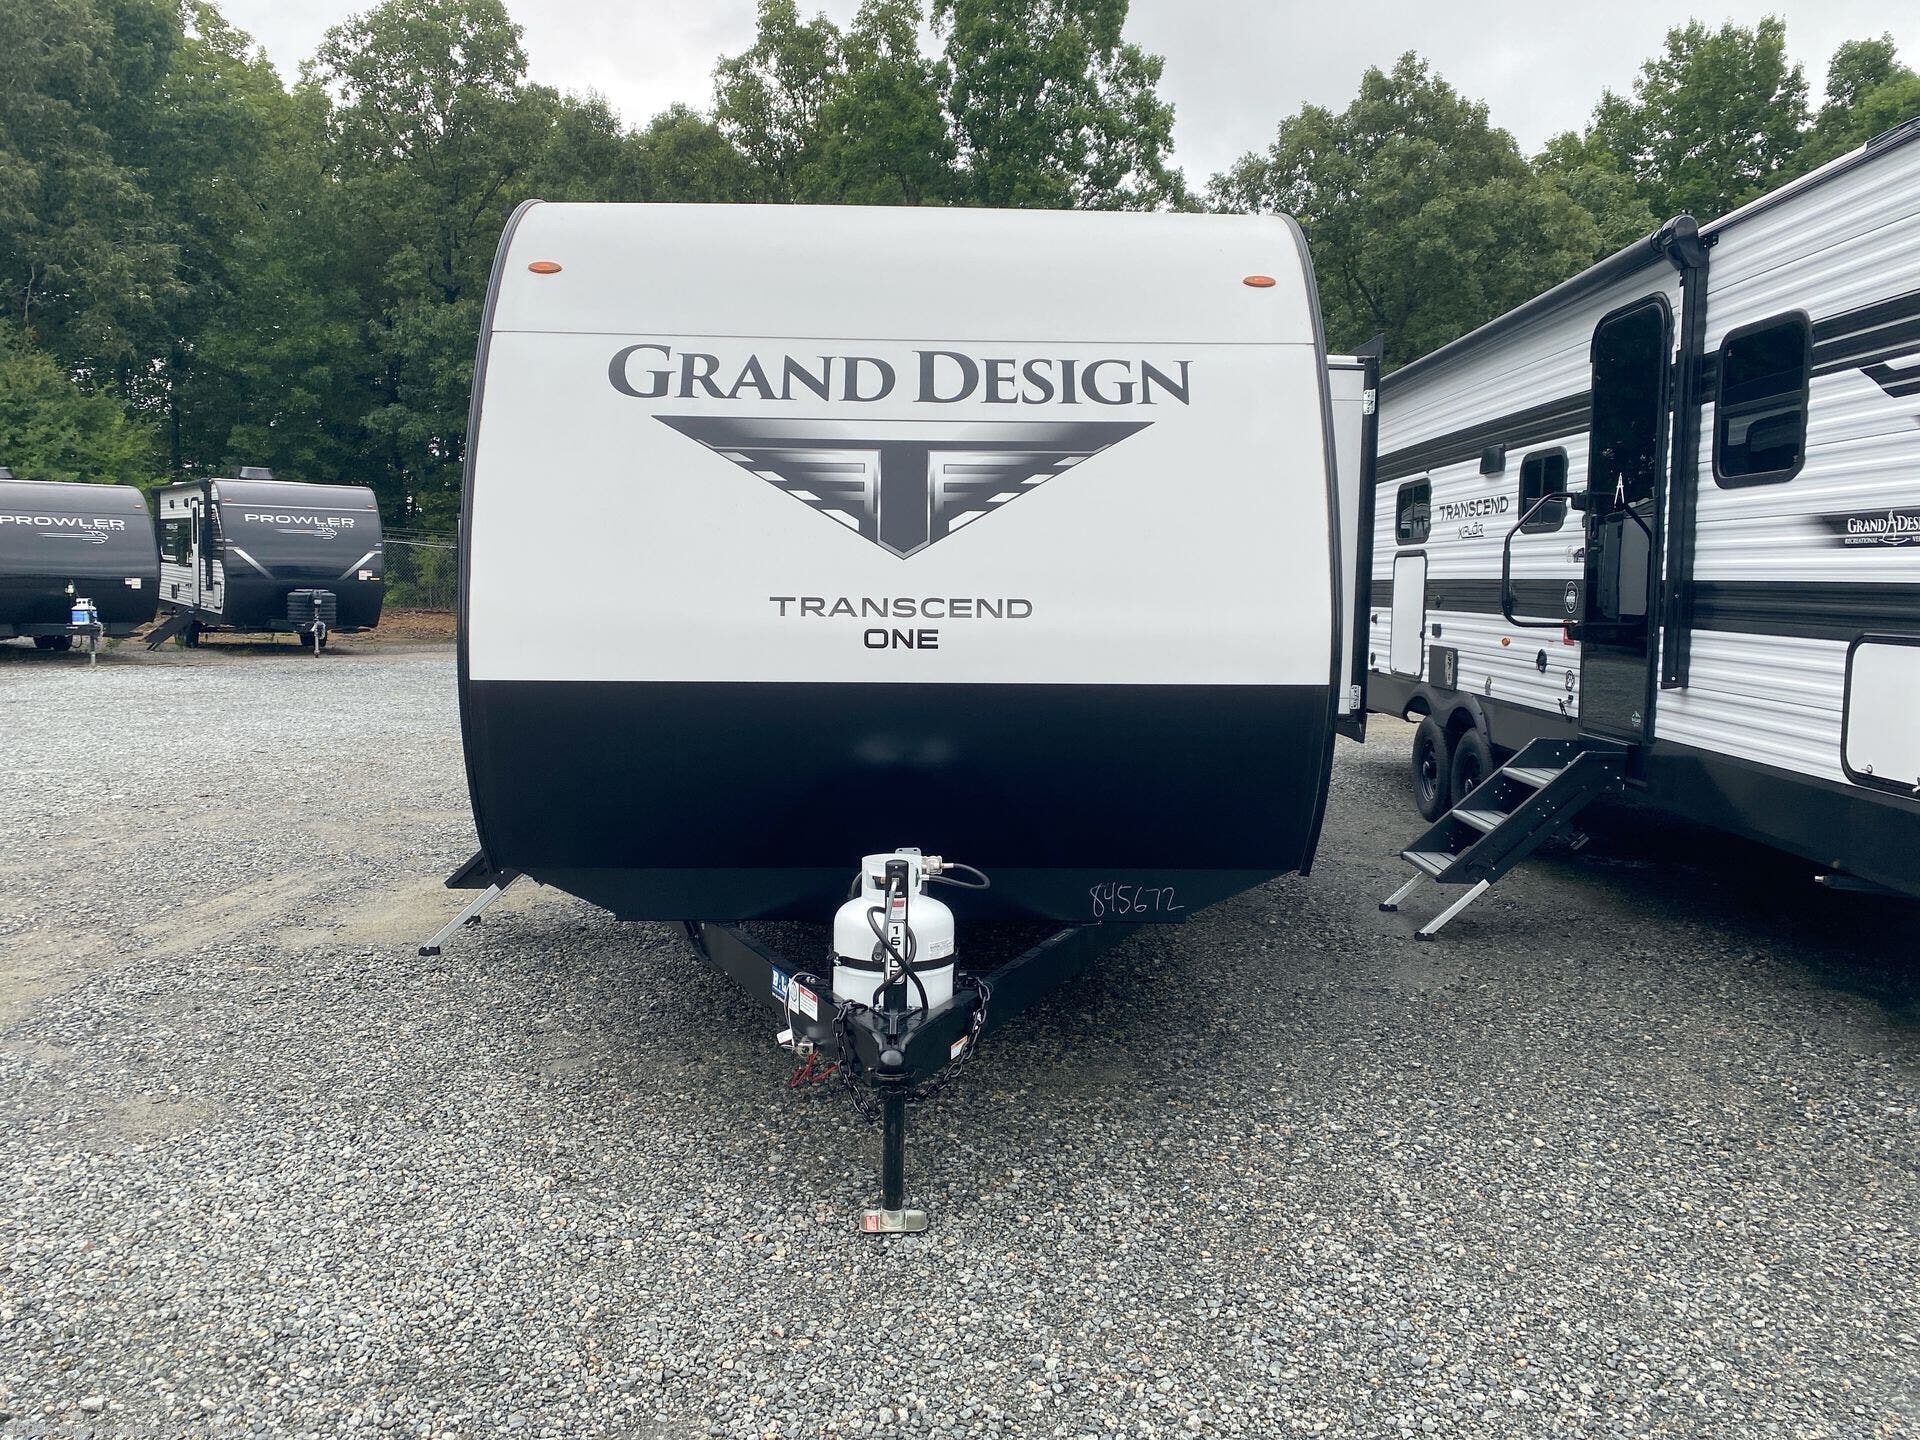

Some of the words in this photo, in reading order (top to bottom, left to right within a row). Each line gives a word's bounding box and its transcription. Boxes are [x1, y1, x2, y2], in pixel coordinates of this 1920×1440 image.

[608, 343, 896, 402] GRAND
[912, 350, 1194, 406] DESIGN
[244, 513, 355, 526] PROWLER
[1439, 496, 1509, 521] TRANSCEND
[1847, 518, 1887, 533] GRAND
[769, 596, 1033, 619] TRANSCEND
[863, 628, 939, 650] ONE
[1089, 882, 1185, 917] 845672
